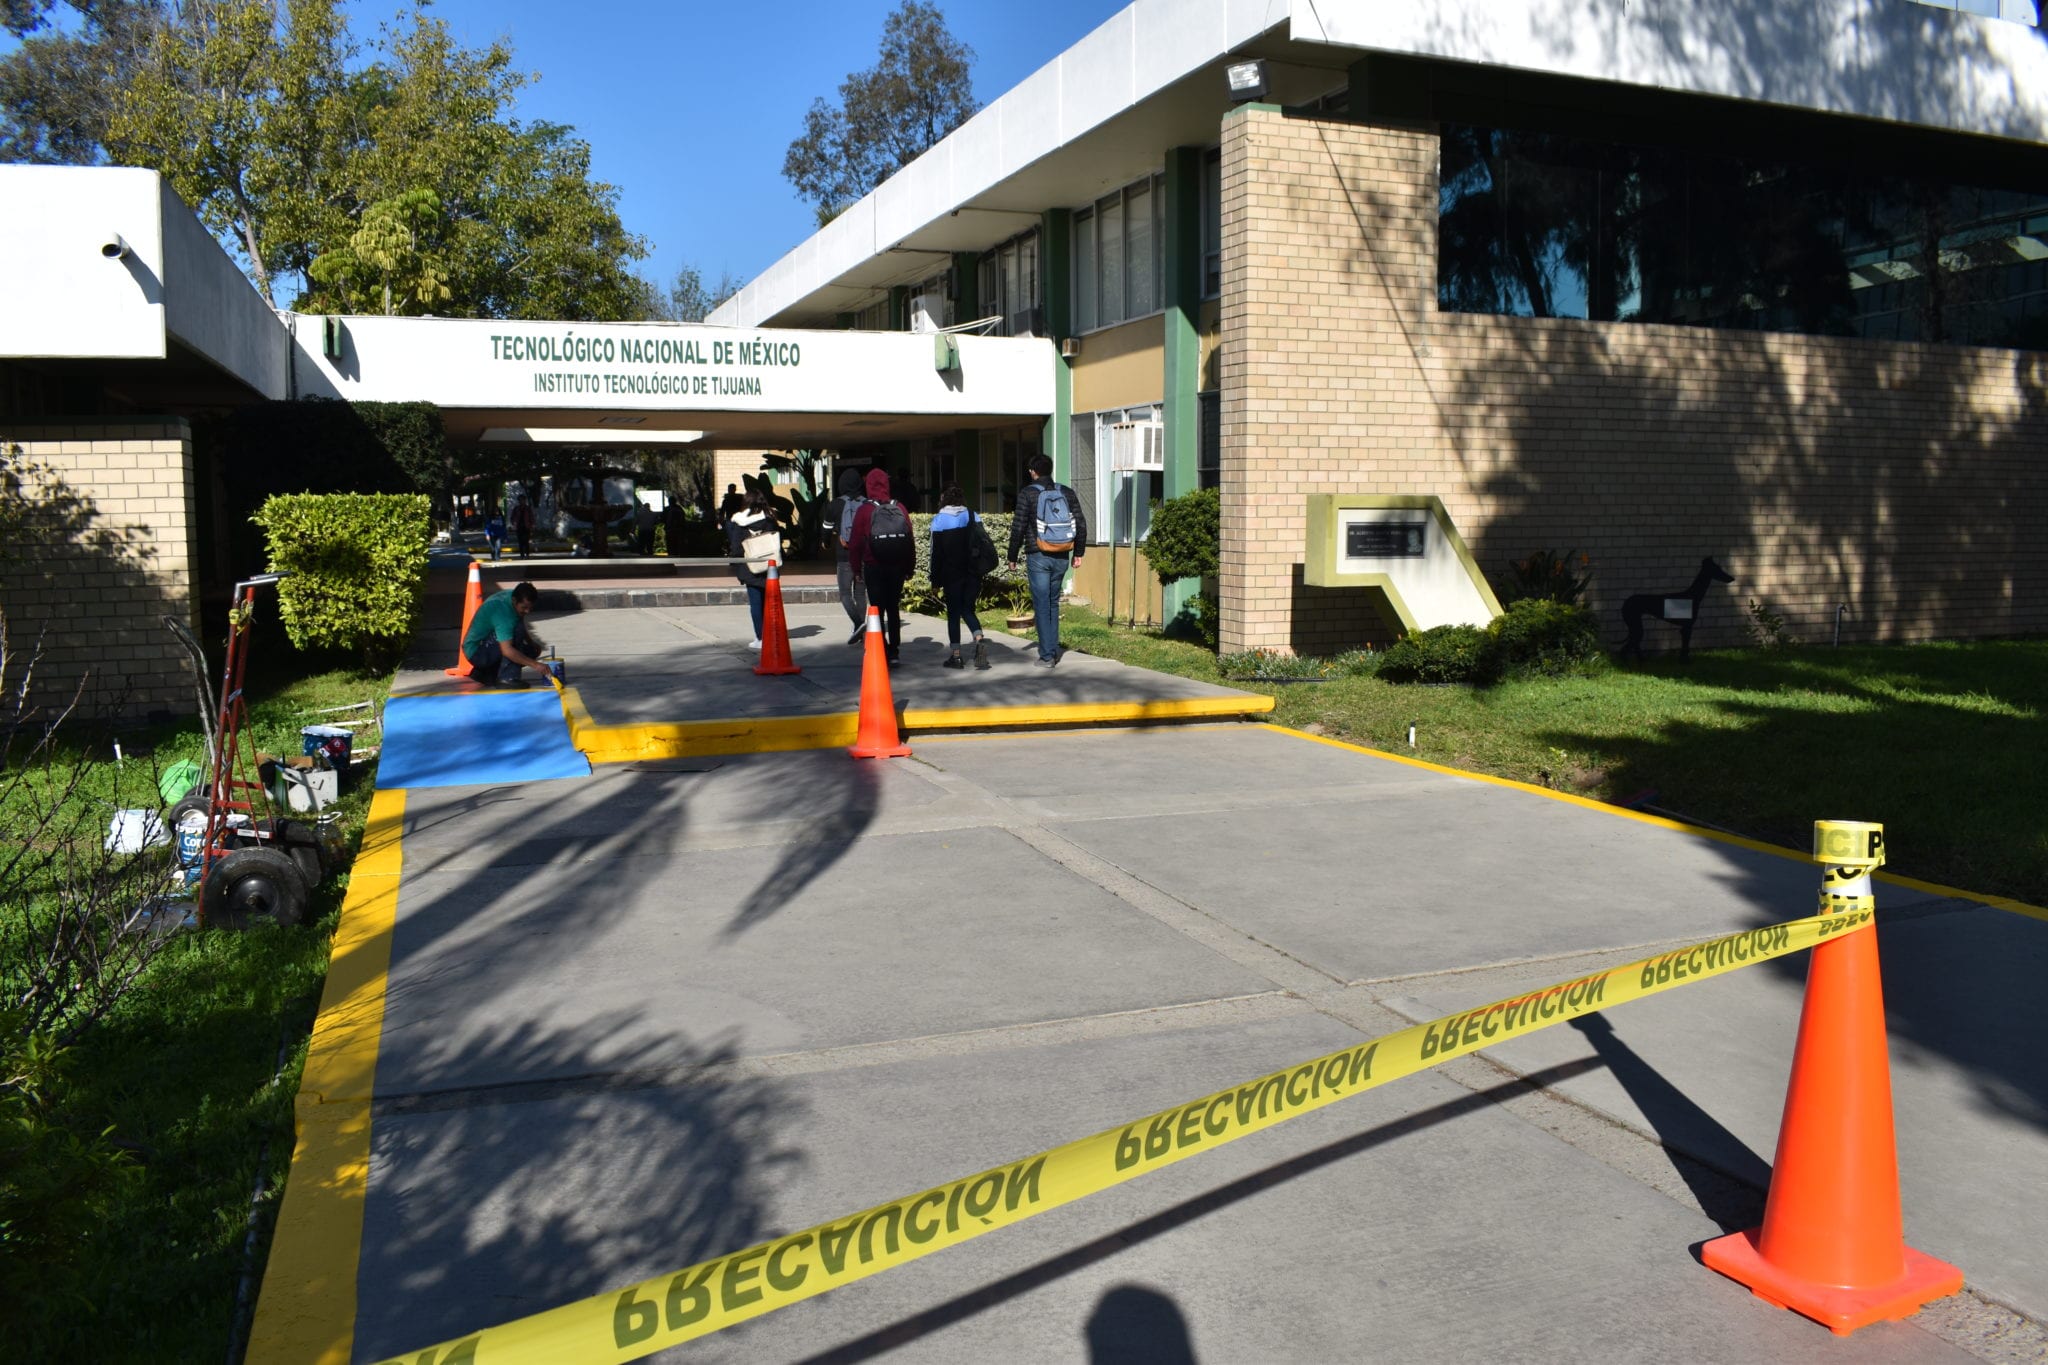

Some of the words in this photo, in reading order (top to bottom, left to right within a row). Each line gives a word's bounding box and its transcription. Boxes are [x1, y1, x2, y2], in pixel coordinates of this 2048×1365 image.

[491, 331, 614, 362] TECNOLÓGICO
[621, 339, 707, 364] NACIONAL
[713, 342, 734, 365] DE
[739, 336, 800, 366] MÉXICO
[534, 373, 600, 393] INSTITUTO
[603, 371, 689, 395] TECNOLÓGICO
[693, 376, 708, 394] DE
[711, 376, 762, 396] TIJUANA
